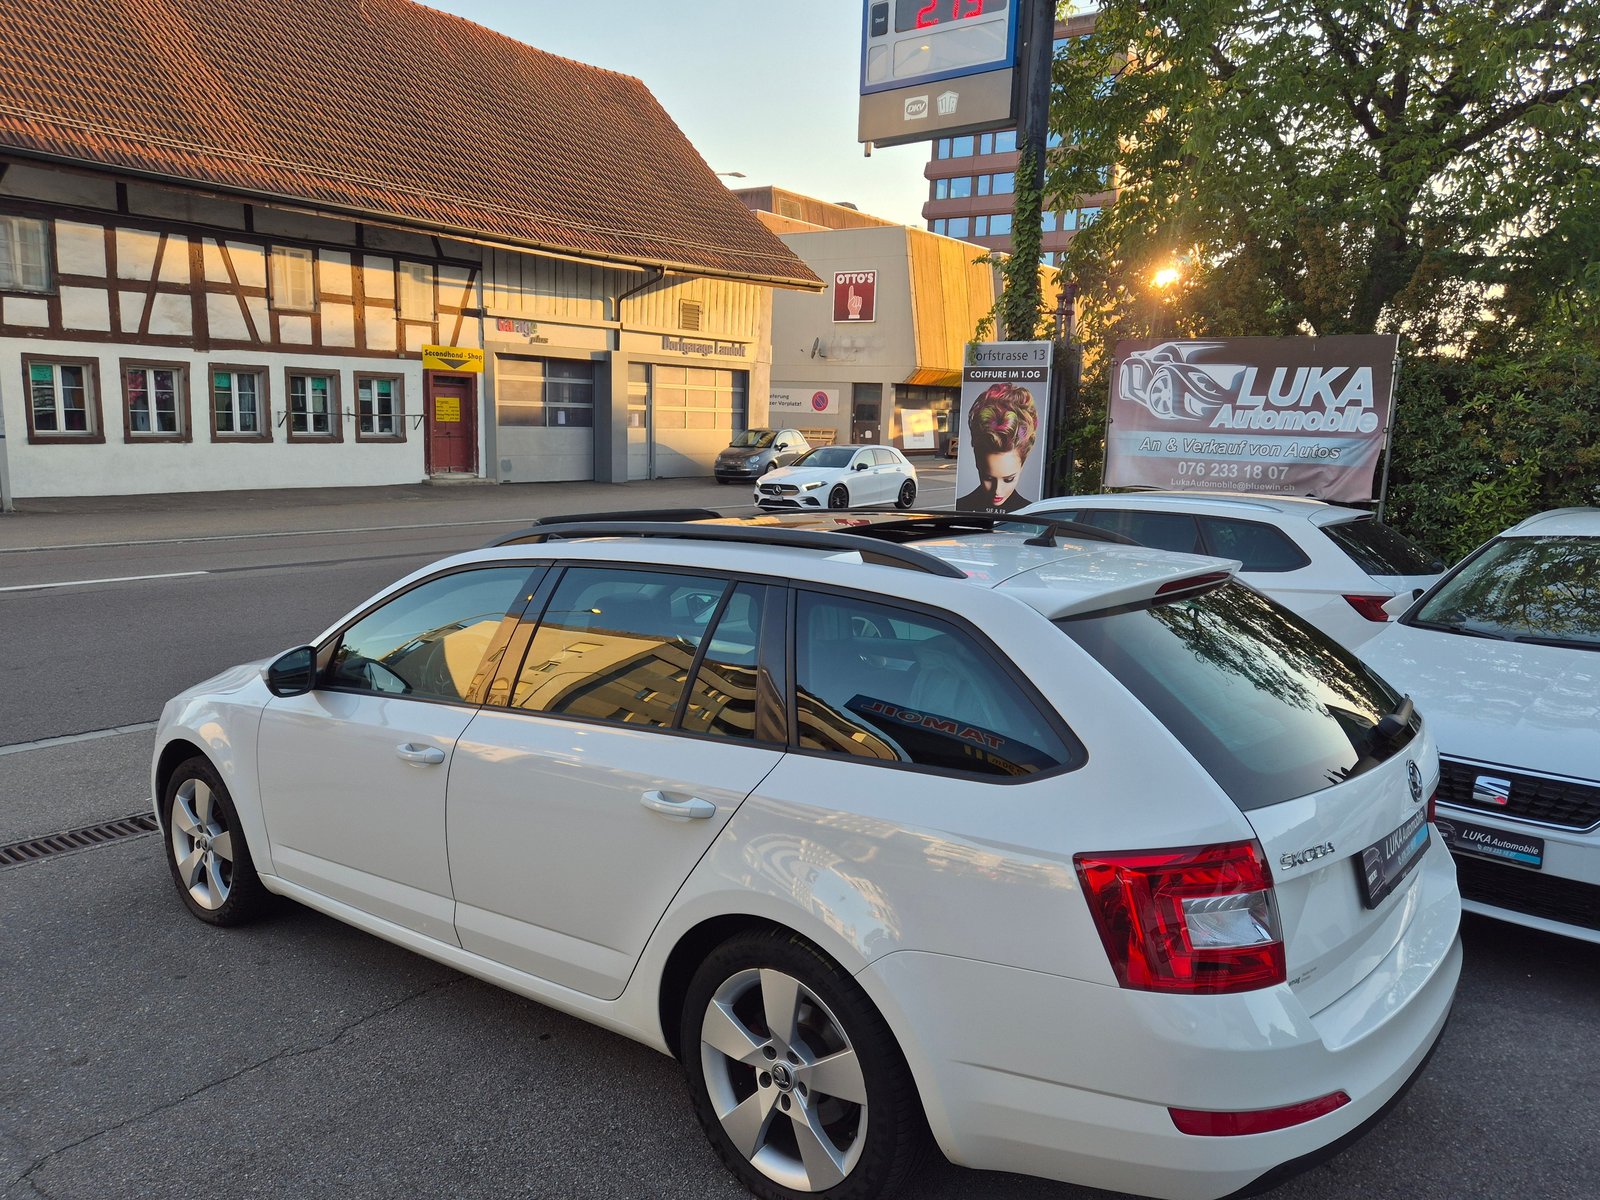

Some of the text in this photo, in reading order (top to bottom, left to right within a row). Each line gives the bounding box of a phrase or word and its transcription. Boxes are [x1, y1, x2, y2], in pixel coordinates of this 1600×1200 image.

[907, 102, 925, 113] DKV
[836, 273, 873, 285] OTTO'S
[529, 335, 549, 344] plus
[662, 335, 713, 356] Dorfgarage
[424, 349, 463, 359] Secondhand
[468, 352, 482, 362] Shop
[974, 349, 1045, 362] orfstrasse 13
[970, 370, 1006, 379] COIFFURE
[1008, 370, 1019, 378] IM
[1236, 366, 1374, 408] LUKA
[1209, 403, 1379, 433] Automobile
[1139, 437, 1341, 460] An & Verkauf von Autos
[1178, 461, 1289, 480] 076 233 18 07
[1171, 478, 1295, 492] LukaAutomobile@bluewin.ch
[1385, 828, 1404, 859] LUKA
[1403, 810, 1424, 842] Automobile
[1462, 829, 1491, 844] LUKA
[1491, 839, 1539, 855] Automobile
